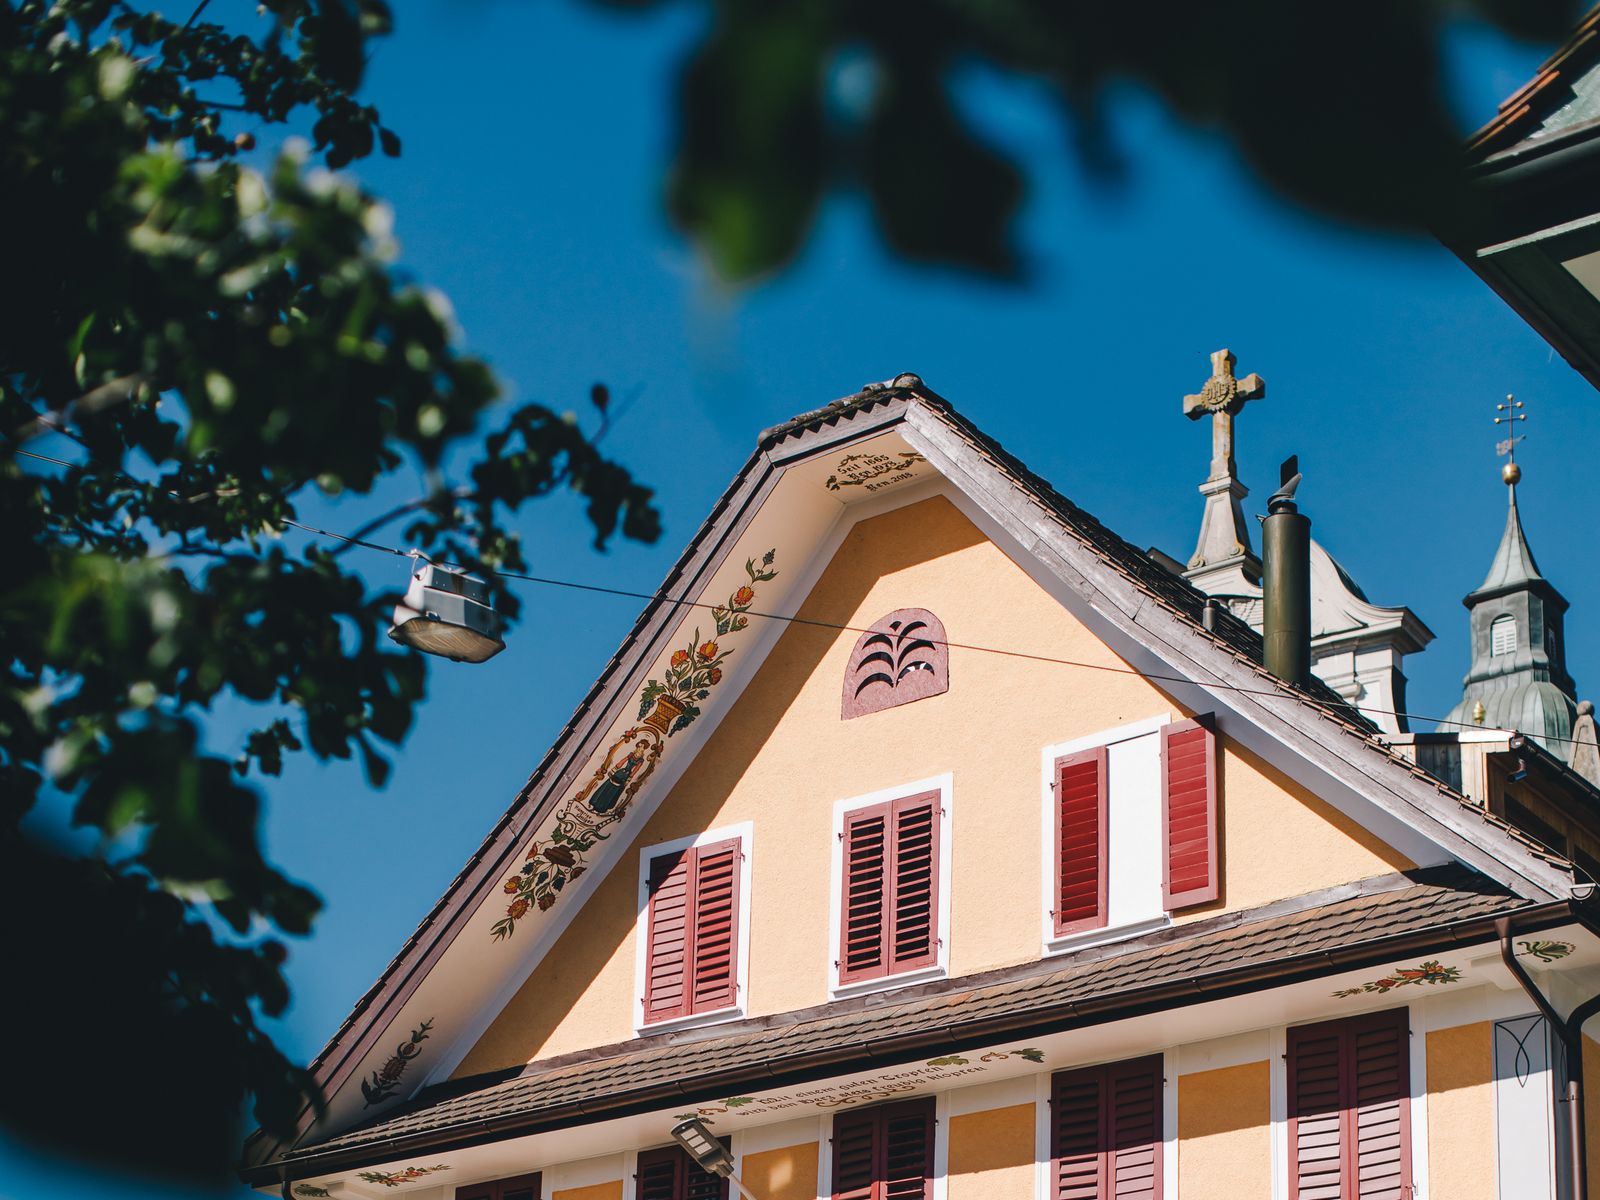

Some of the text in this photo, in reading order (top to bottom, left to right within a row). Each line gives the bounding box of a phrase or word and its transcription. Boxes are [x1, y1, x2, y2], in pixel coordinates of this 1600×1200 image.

[837, 455, 889, 474] Seit 1665
[757, 1066, 944, 1105] Mit einem guten Tropfen
[797, 1094, 836, 1105] Herz
[927, 1066, 988, 1080] klopfen
